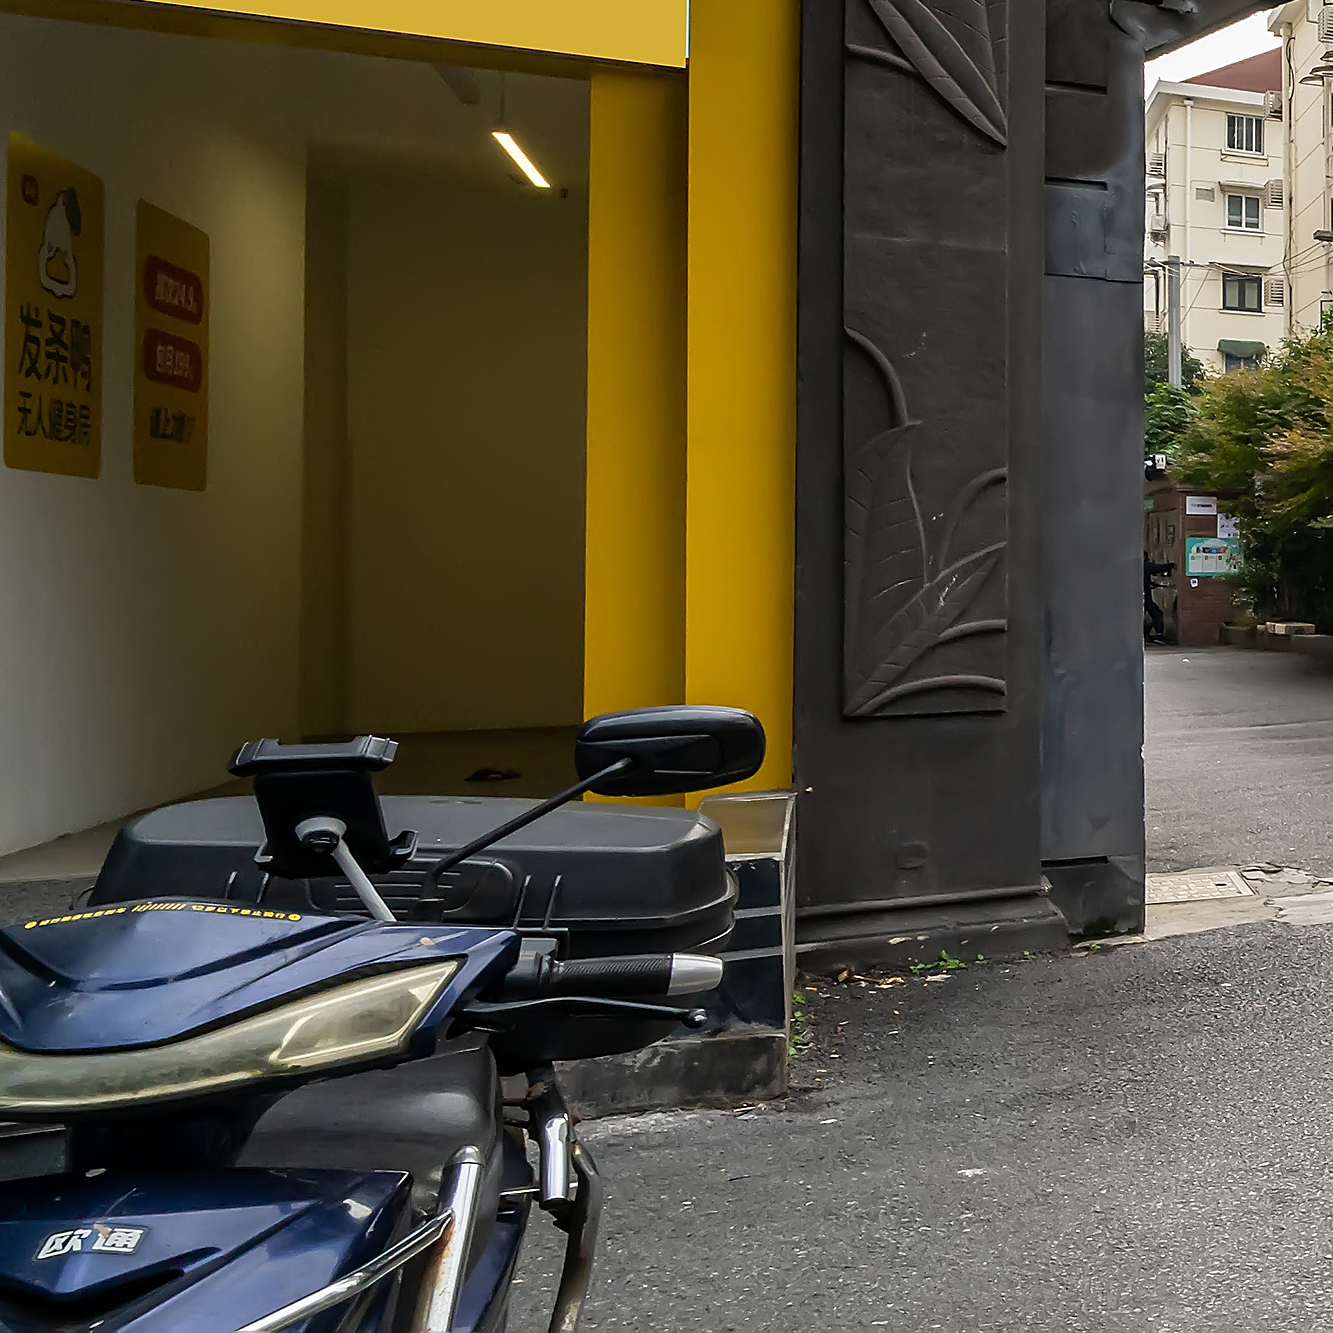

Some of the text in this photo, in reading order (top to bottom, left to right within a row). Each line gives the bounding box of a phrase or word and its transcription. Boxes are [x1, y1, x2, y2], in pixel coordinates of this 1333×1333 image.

[17, 390, 91, 447] 无人健身房
[37, 1229, 144, 1259] 欧通
